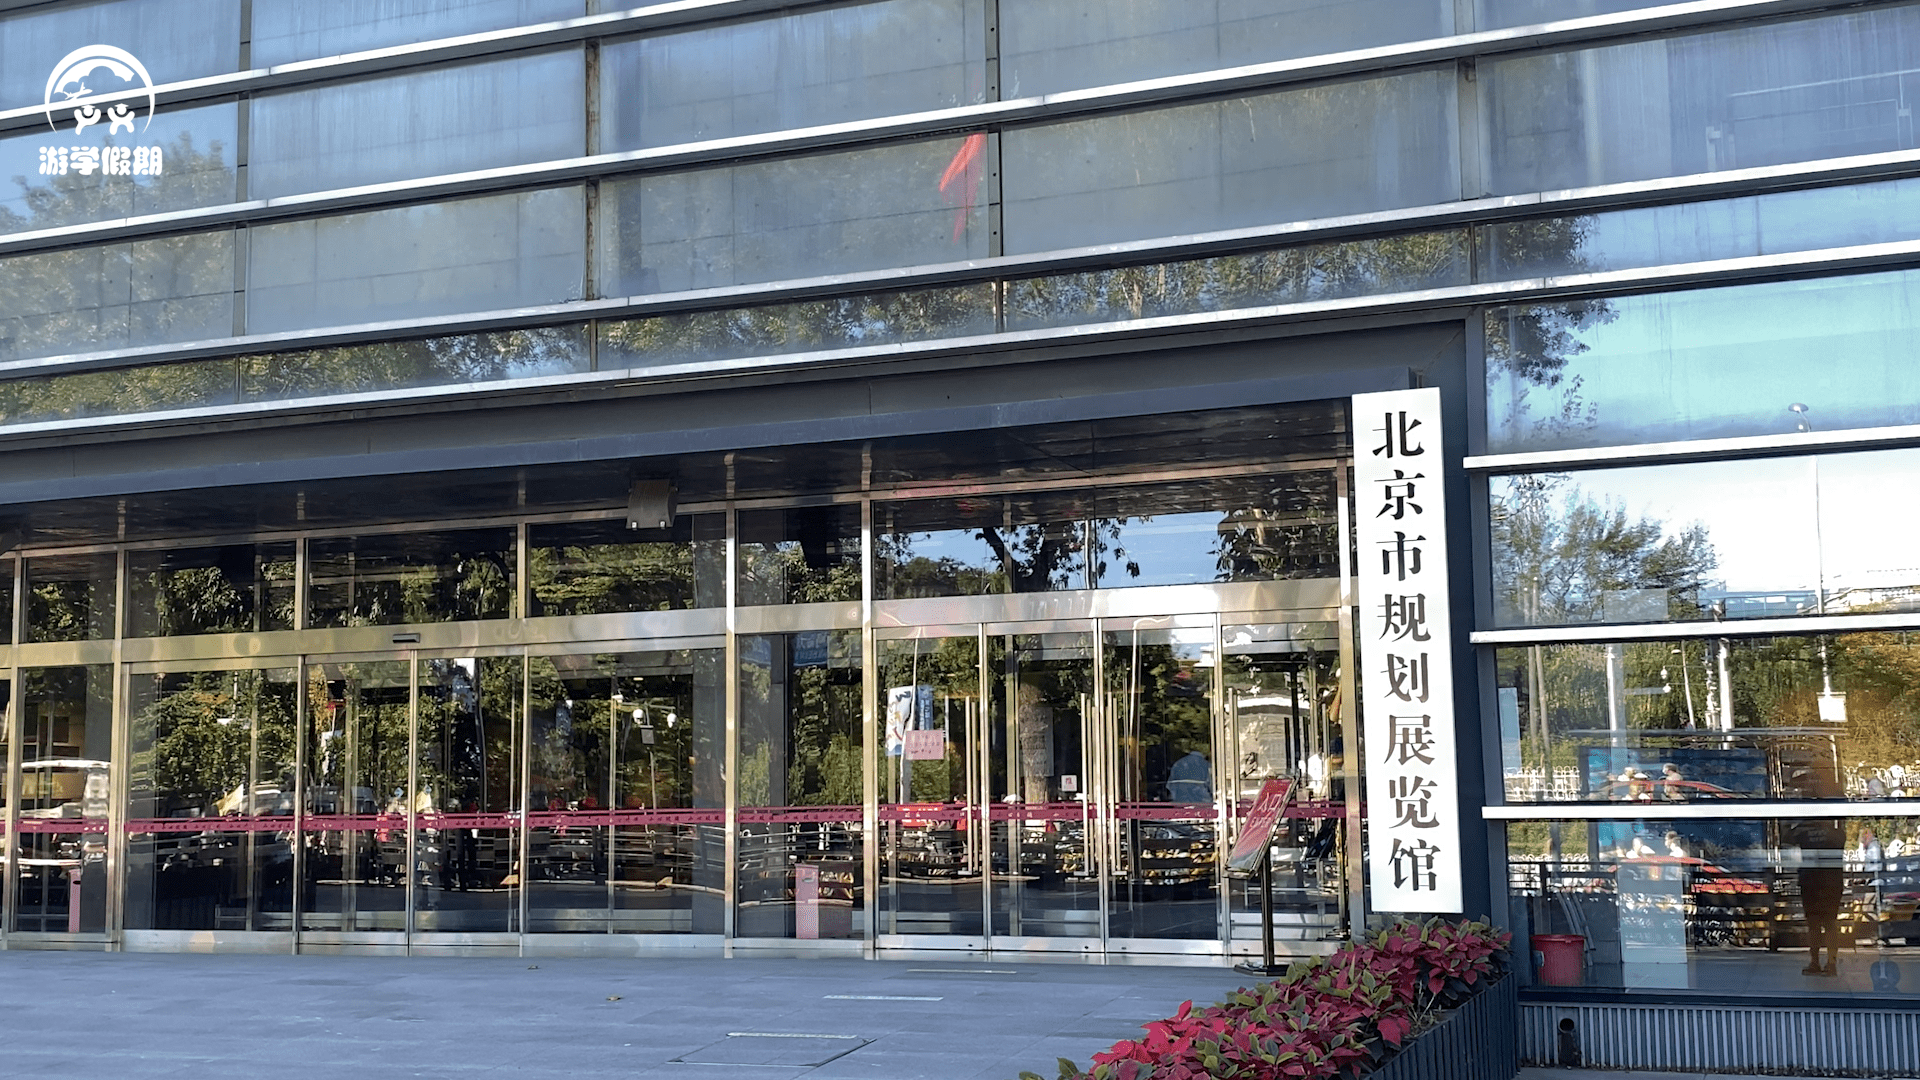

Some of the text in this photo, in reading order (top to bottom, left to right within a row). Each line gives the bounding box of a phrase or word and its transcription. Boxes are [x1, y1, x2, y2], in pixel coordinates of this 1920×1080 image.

[1371, 410, 1441, 892] 北京市规划展览馆
